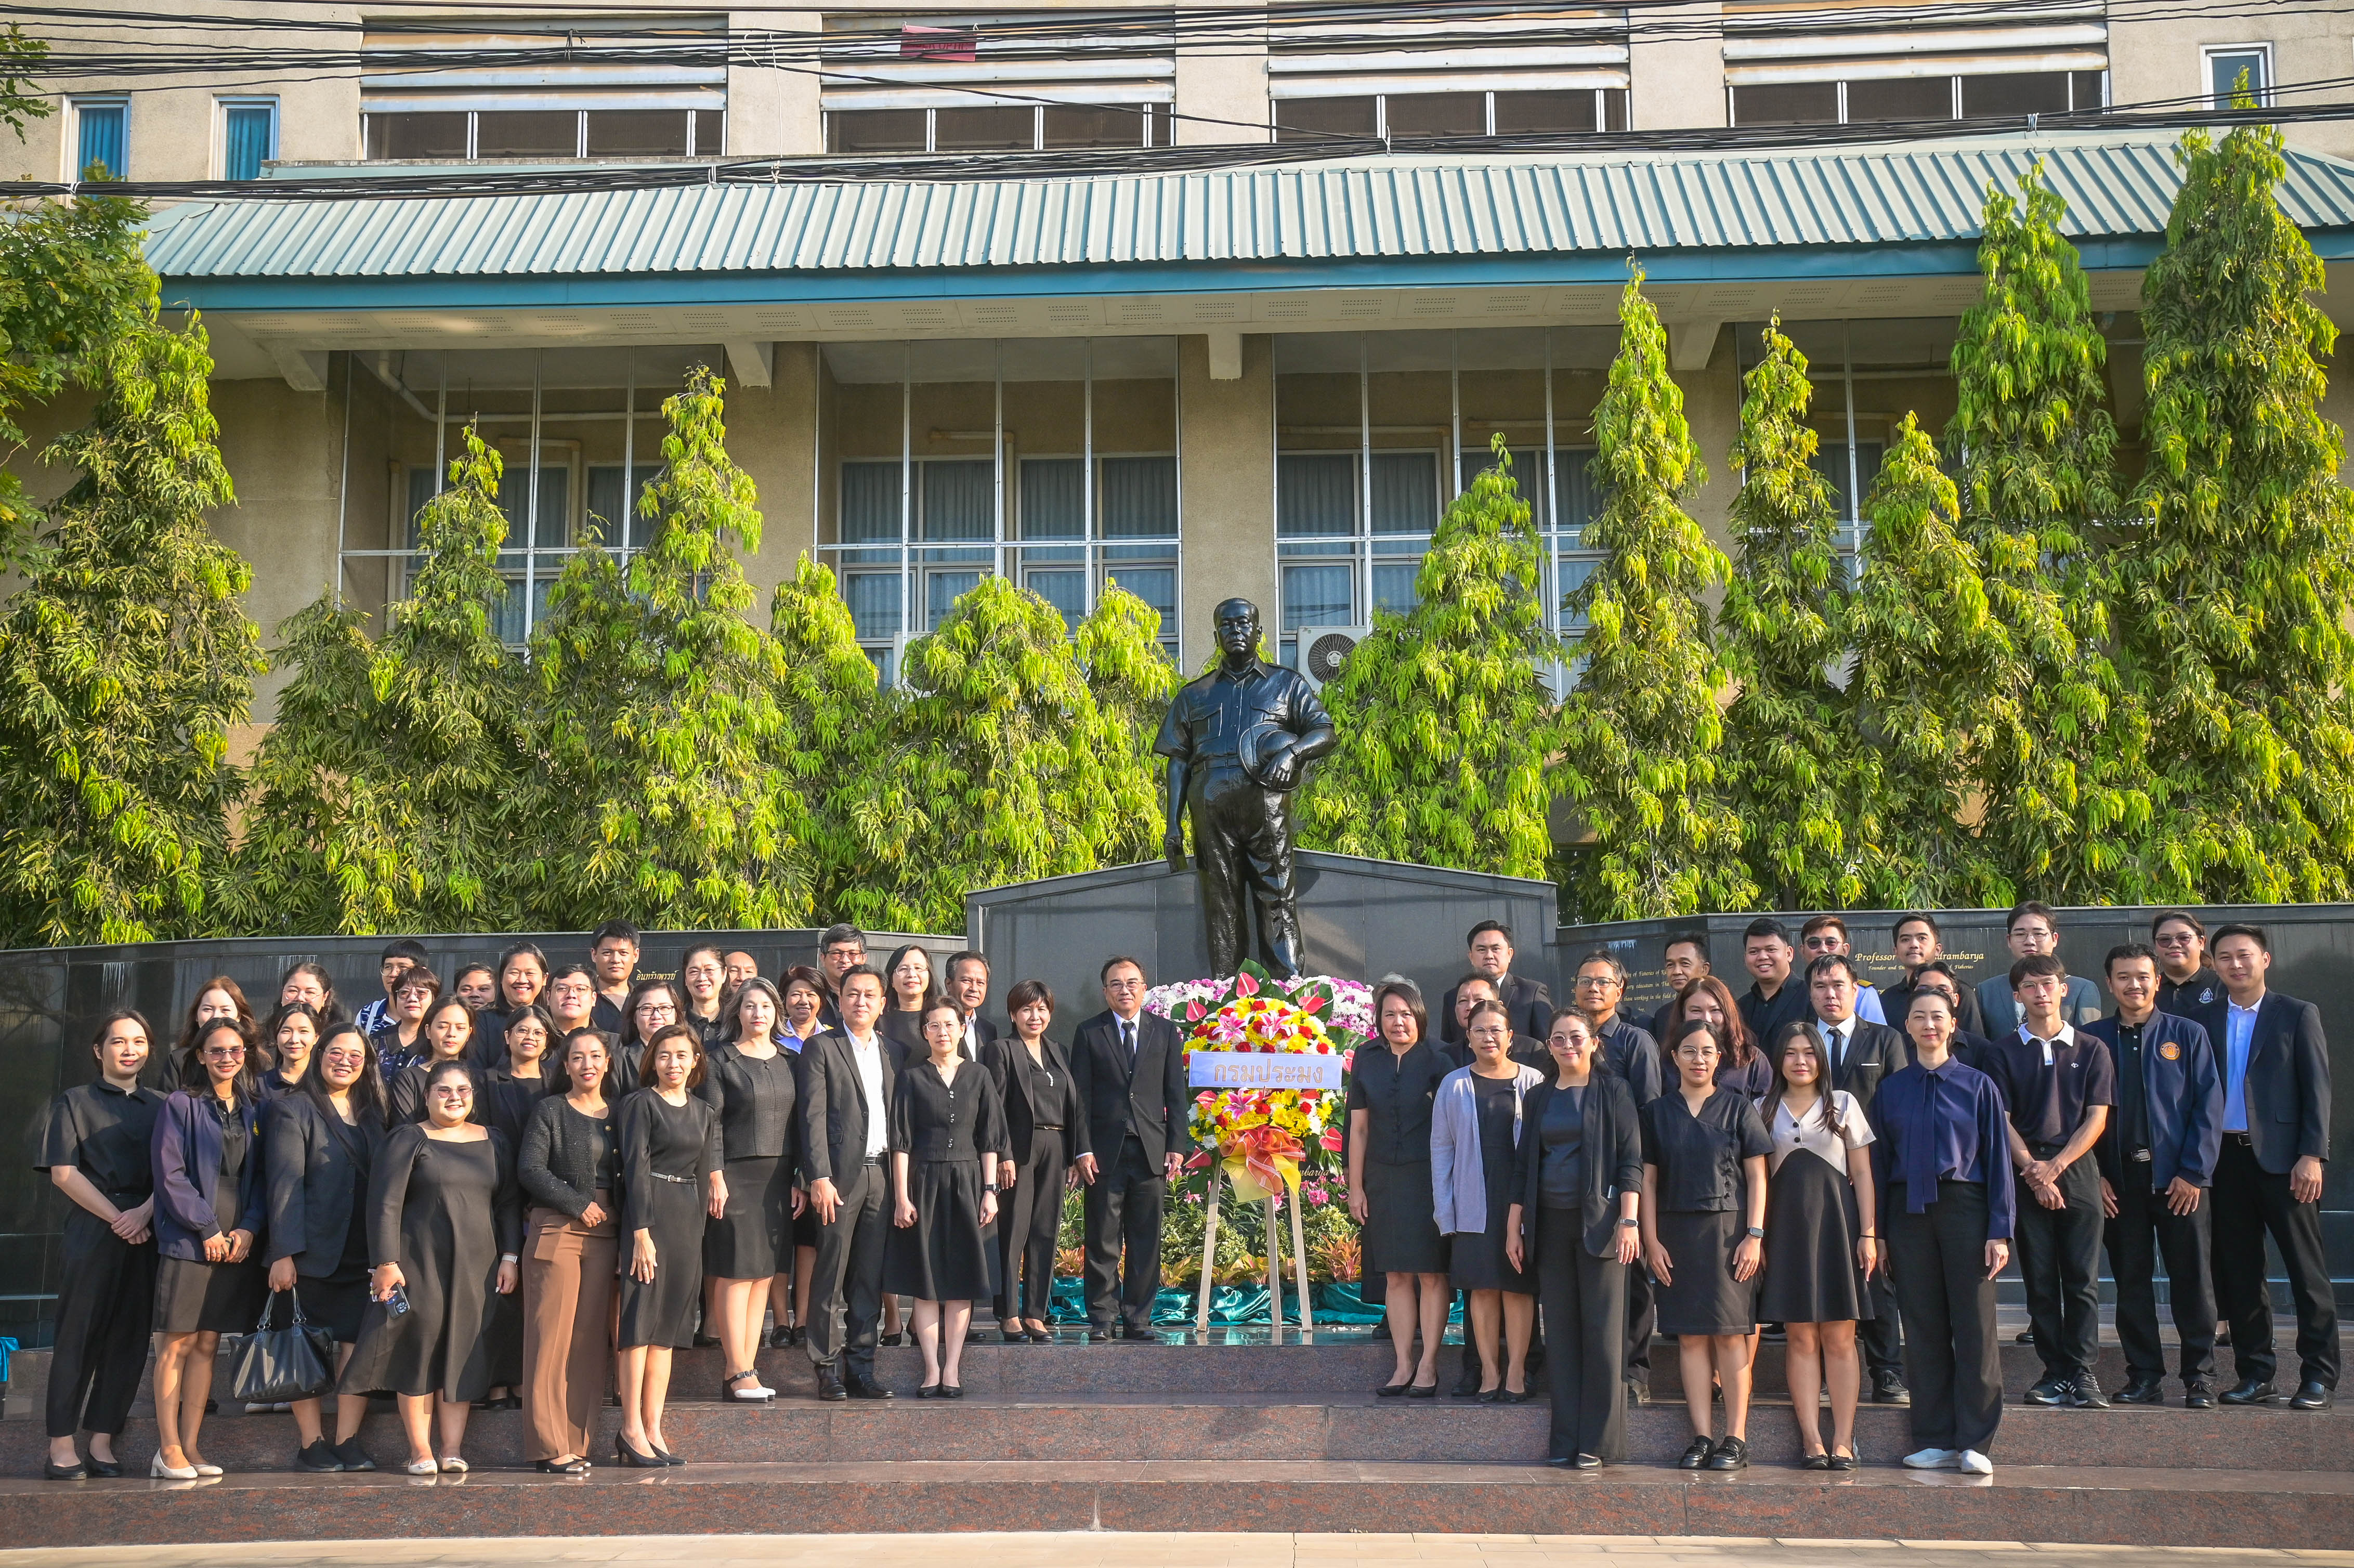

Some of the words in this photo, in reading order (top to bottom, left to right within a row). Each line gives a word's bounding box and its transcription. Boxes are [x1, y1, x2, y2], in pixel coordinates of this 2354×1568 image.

[1855, 952, 1897, 964] Professor
[1934, 950, 1984, 962] drambarya
[1662, 992, 1671, 1001] field
[1672, 992, 1677, 1000] of
[1214, 1058, 1323, 1083] กรมประมง
